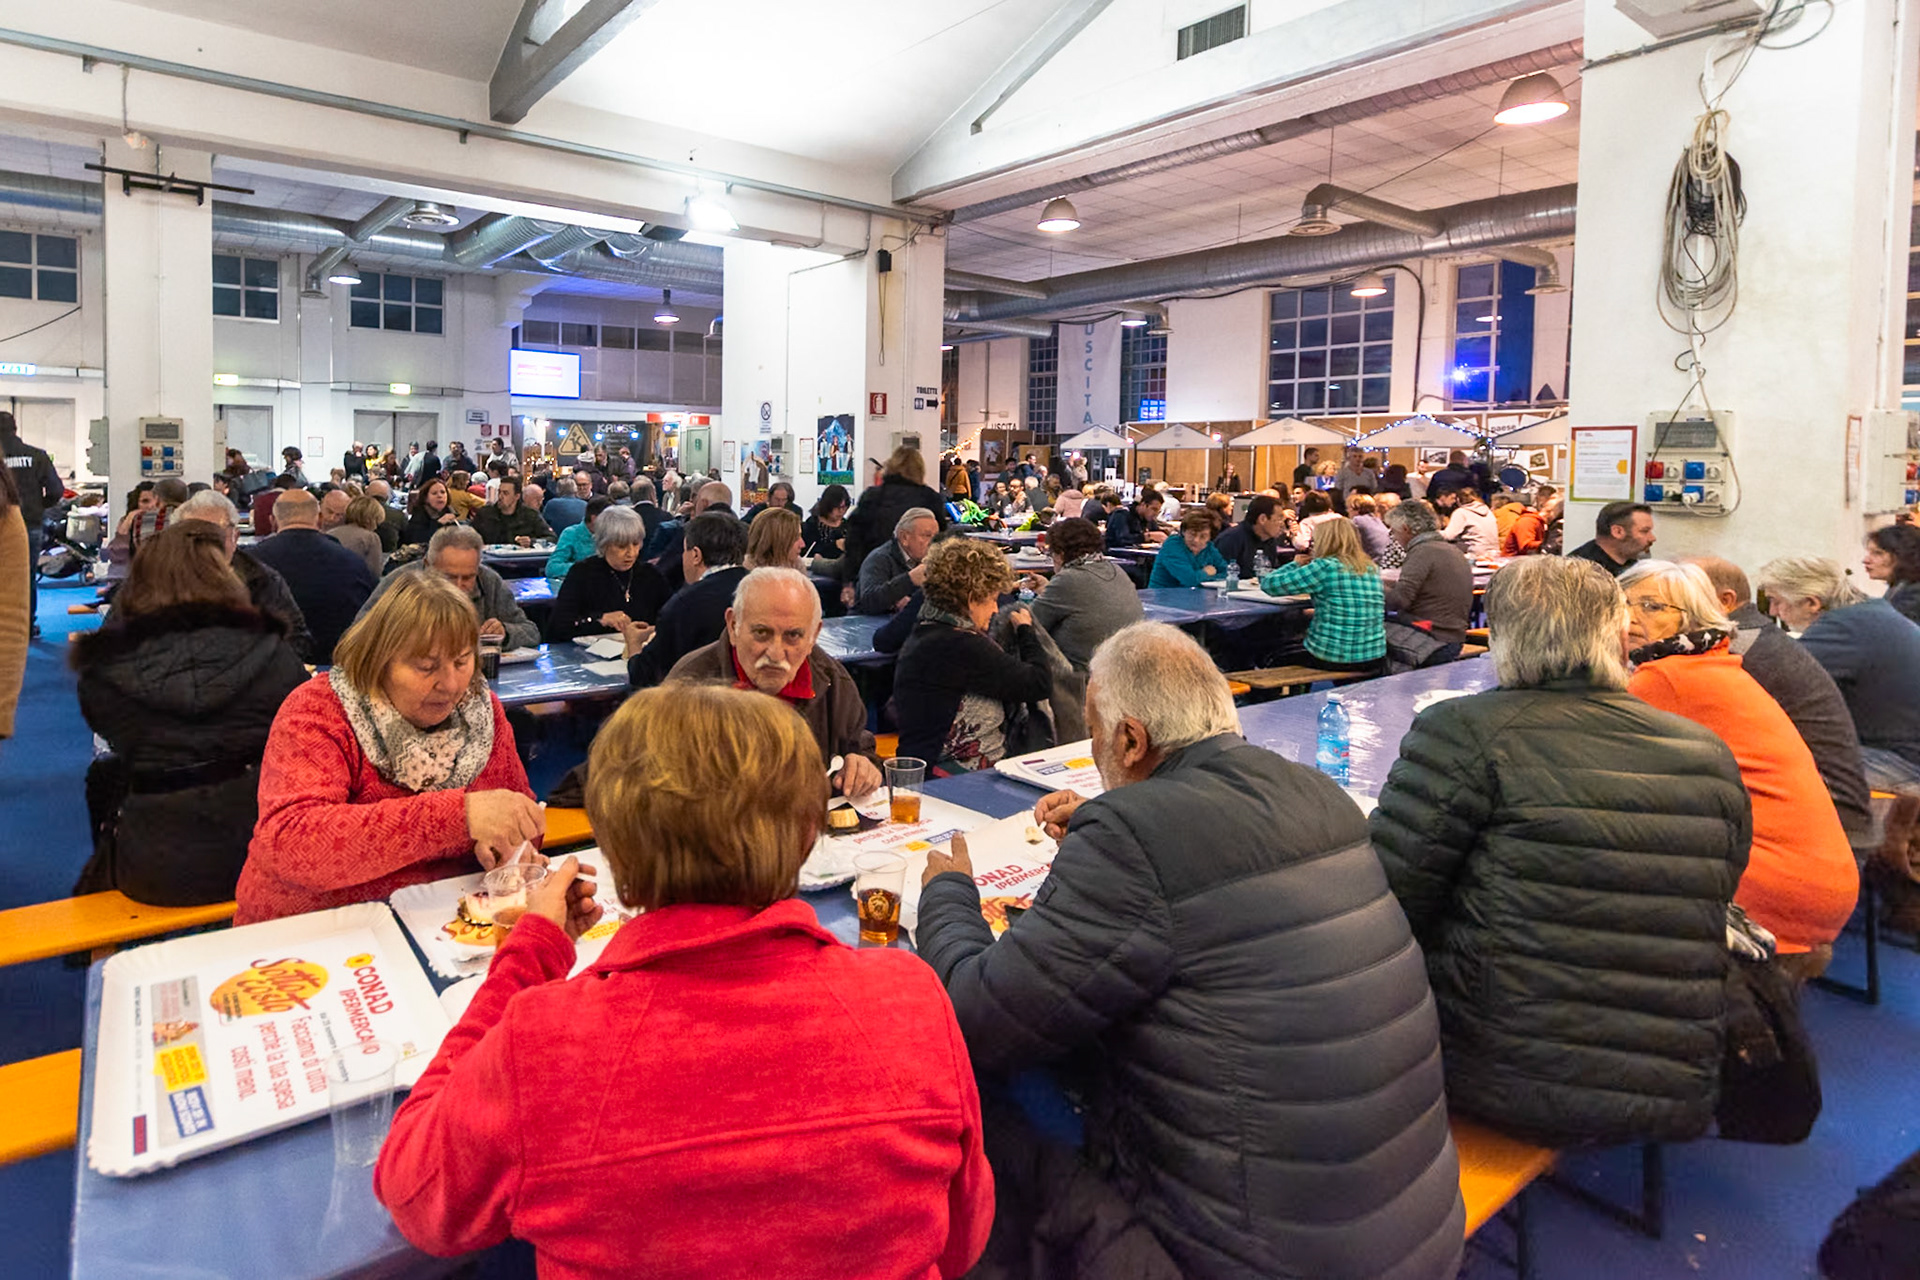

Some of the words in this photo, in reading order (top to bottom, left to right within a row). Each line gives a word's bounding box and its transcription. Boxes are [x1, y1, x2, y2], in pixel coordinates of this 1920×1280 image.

[1083, 323, 1095, 424] USCITA
[916, 386, 938, 395] TOILETTE
[973, 864, 1023, 888] ONAD
[250, 956, 321, 993] Sotto
[353, 965, 394, 1015] CONAD
[339, 987, 381, 1055] IPERMERCAO
[230, 1044, 258, 1070] costi
[266, 1048, 289, 1063] la
[269, 1060, 290, 1079] tua
[290, 1015, 317, 1059] Facciamo
[306, 1067, 328, 1094] tutto
[235, 1067, 257, 1102] meno.
[267, 1078, 297, 1110] spesa
